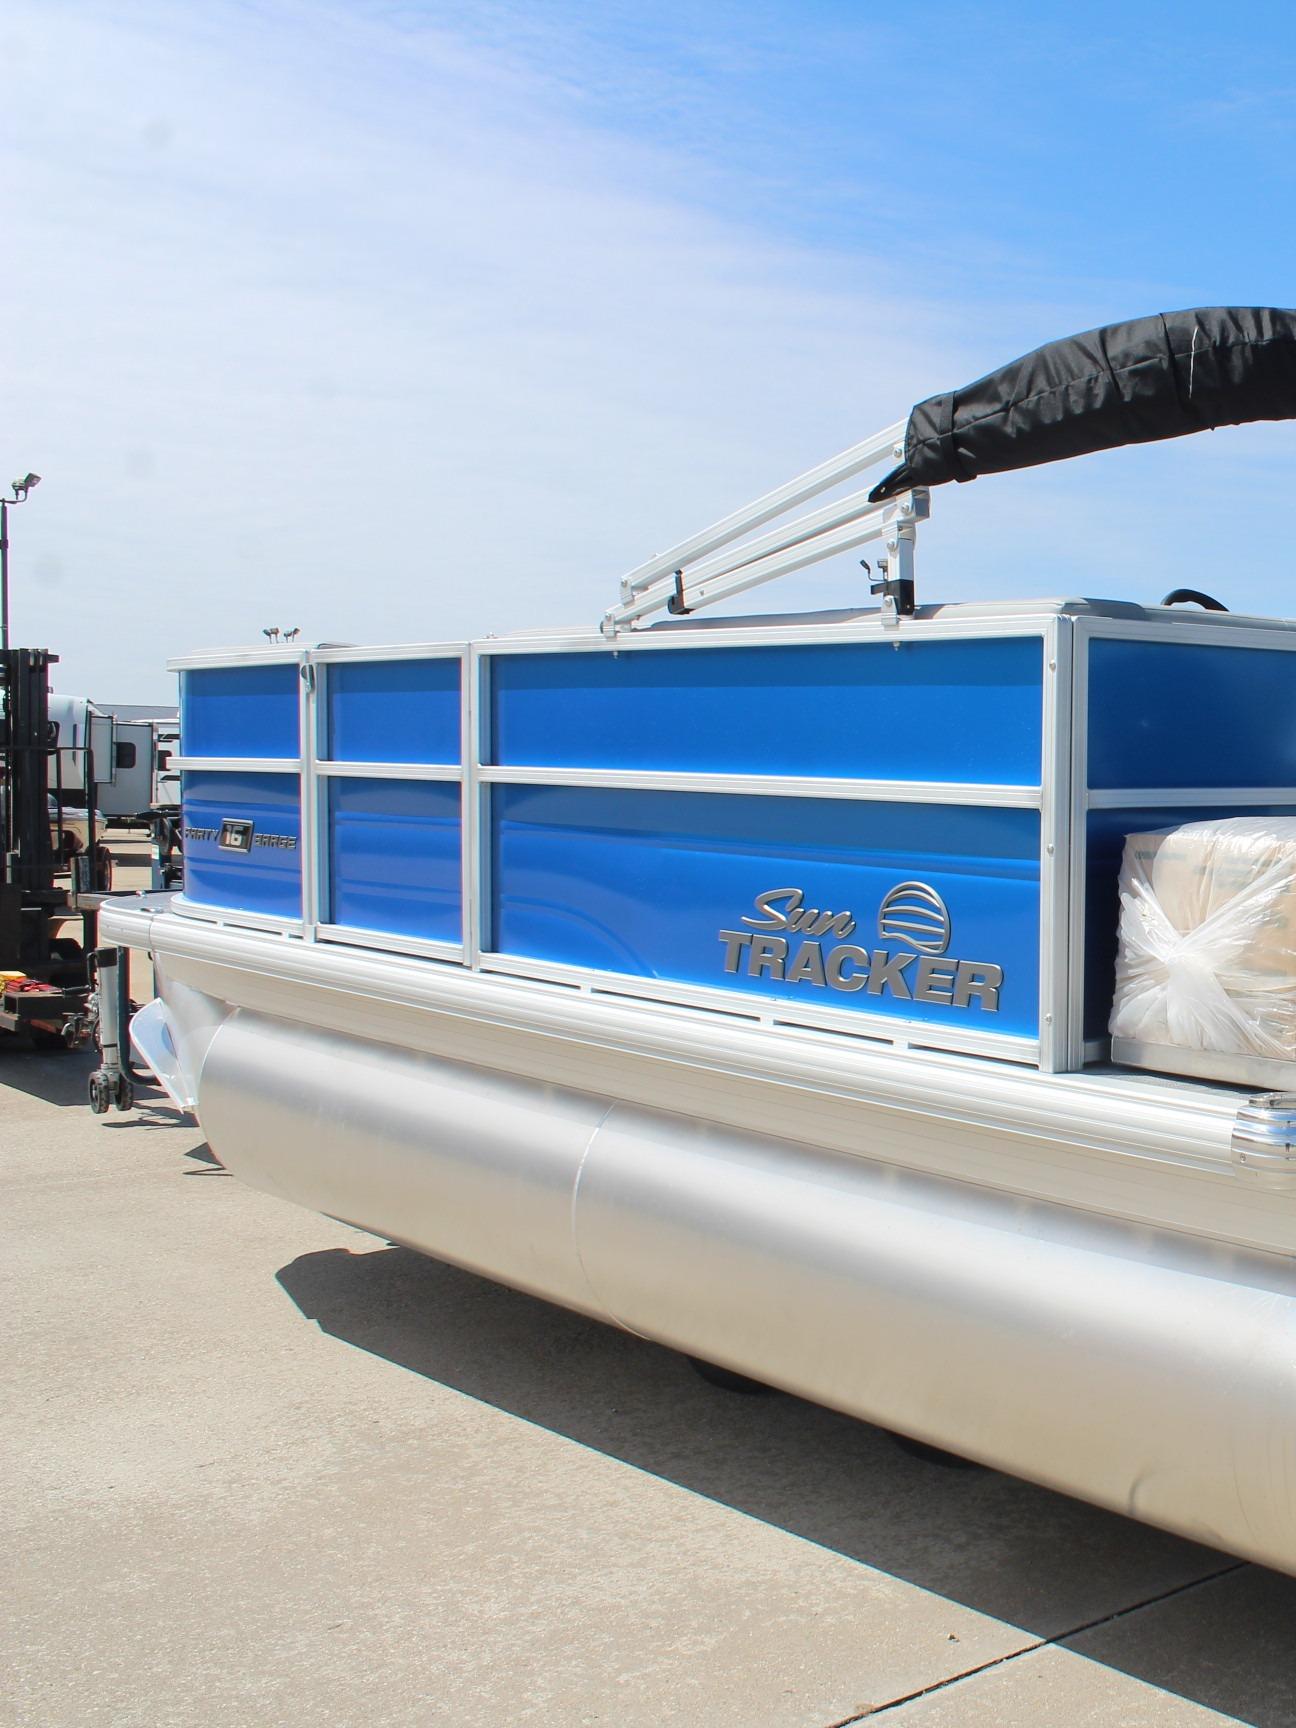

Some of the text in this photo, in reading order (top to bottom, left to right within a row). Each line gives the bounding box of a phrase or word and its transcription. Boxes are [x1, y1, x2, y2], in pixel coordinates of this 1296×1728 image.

[224, 824, 244, 847] 16
[255, 832, 297, 850] BARGE
[740, 888, 857, 939] Sun
[719, 929, 1004, 1012] TRACKER
